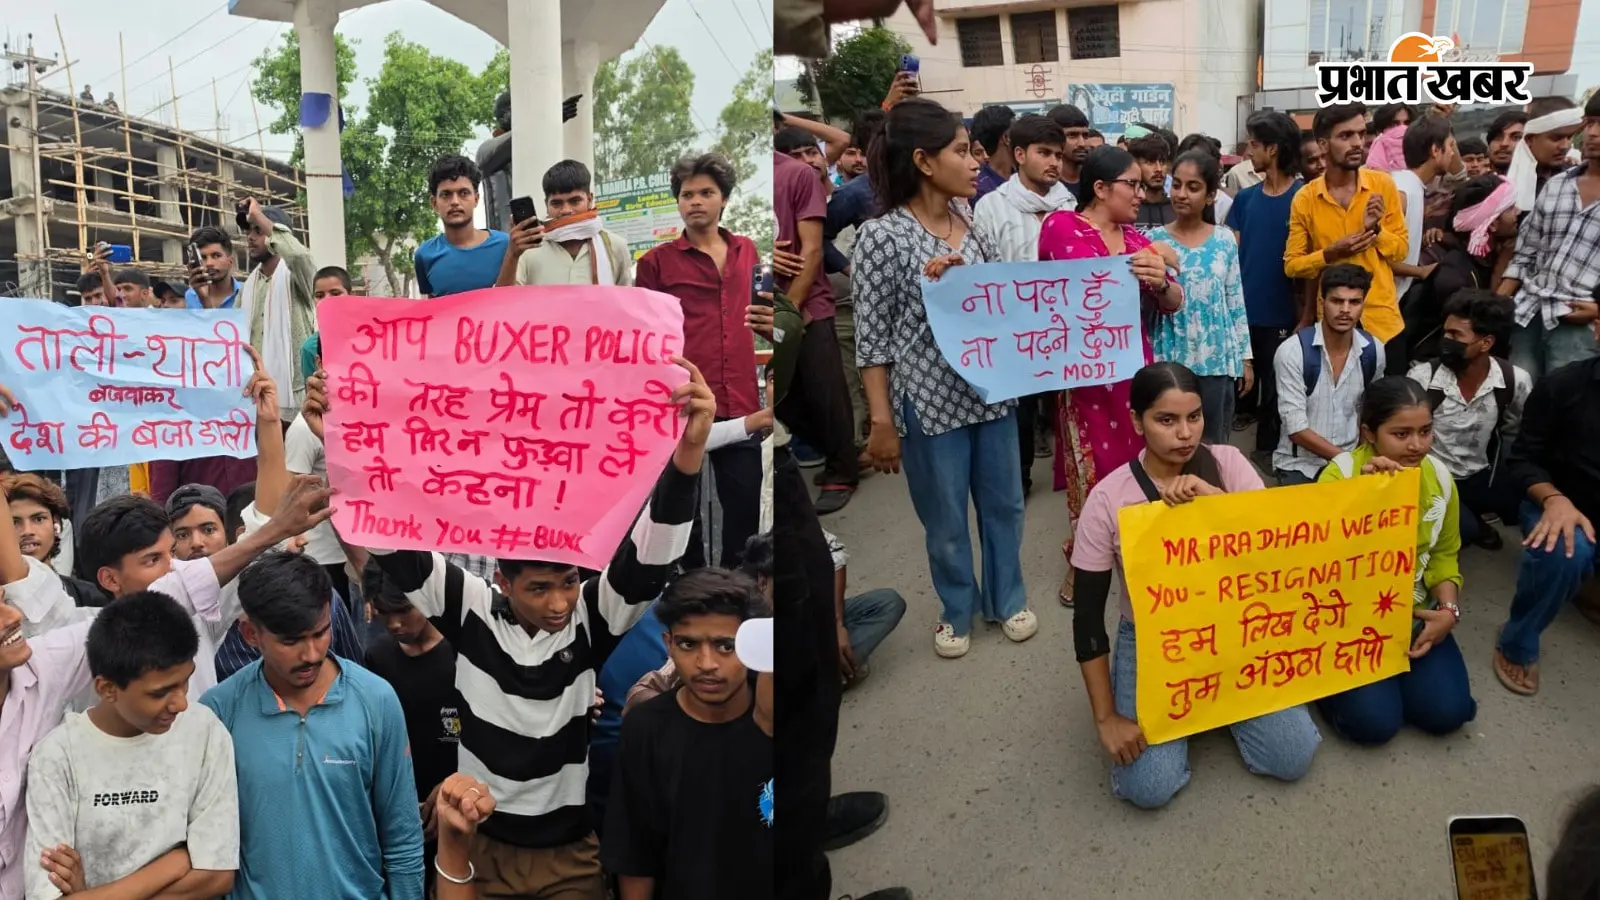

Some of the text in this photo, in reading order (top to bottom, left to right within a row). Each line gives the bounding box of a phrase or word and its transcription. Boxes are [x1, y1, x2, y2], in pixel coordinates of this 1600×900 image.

[961, 282, 1007, 316] ना
[352, 315, 679, 366] आप BUXER POLICE
[960, 337, 998, 368] ना
[337, 362, 380, 409] की
[404, 377, 474, 421] तरह
[486, 371, 548, 430] प्रेम
[560, 379, 606, 430] तो
[1063, 361, 1117, 381] MODI
[10, 403, 254, 455] देश की बजा डाली
[341, 420, 390, 453] हम
[456, 429, 491, 457] न
[598, 431, 650, 479] ले
[362, 456, 402, 493] तो
[345, 499, 423, 541] Thank
[1208, 518, 1331, 561] PRADHAN
[1341, 513, 1374, 540] WE
[1378, 504, 1416, 531] GET
[1218, 547, 1415, 603] RESIGNATION
[1161, 623, 1218, 663] हम
[1239, 602, 1297, 648] लिख
[1166, 671, 1223, 720] तुम
[1334, 626, 1394, 674] छापो
[93, 789, 160, 809] FORWARD
